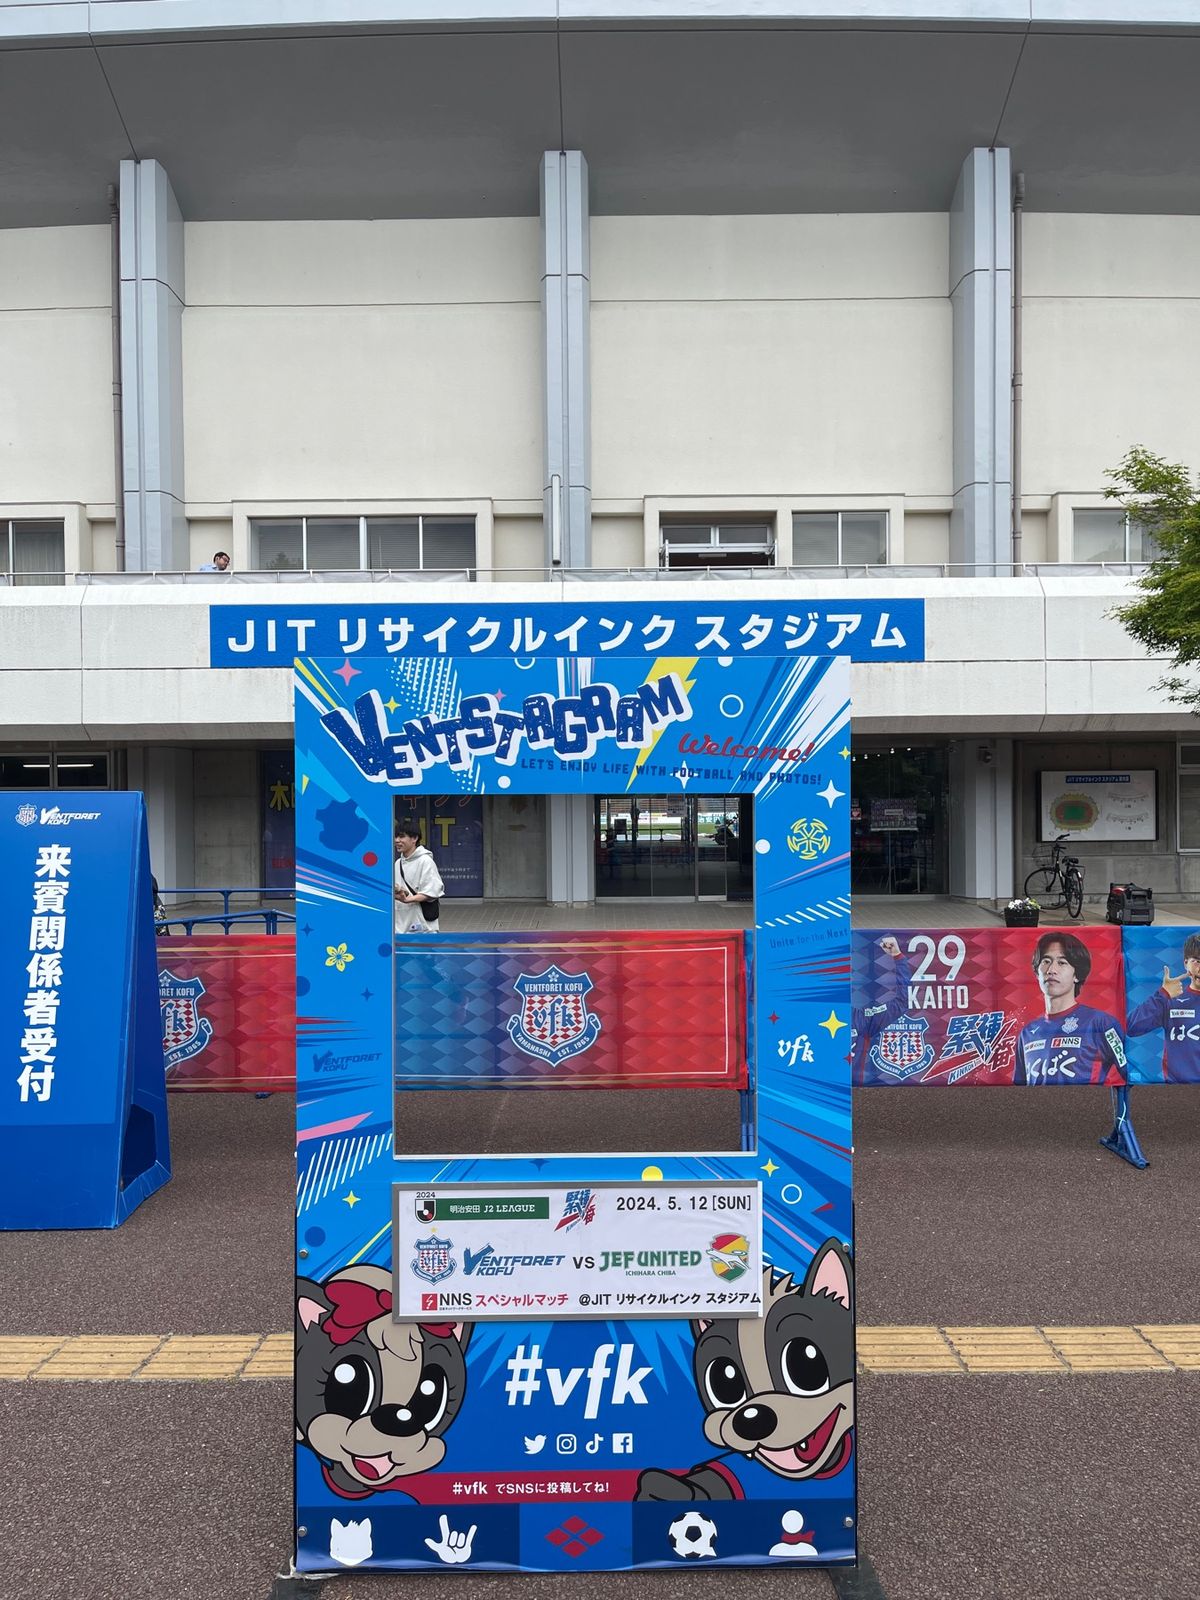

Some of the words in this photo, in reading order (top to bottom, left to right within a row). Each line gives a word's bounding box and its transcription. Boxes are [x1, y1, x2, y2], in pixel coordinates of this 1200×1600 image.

[227, 619, 316, 653] JIT
[339, 614, 676, 654] リサイクルインク
[694, 612, 908, 650] スタジアム
[320, 672, 693, 787] VENTSTAGRAM
[678, 732, 816, 763] Welcome!
[520, 758, 554, 770] LET'S
[560, 760, 598, 772] ENJOY
[603, 763, 629, 775] LIFE
[635, 764, 667, 776] WITH
[673, 766, 733, 780] FOOTBALL
[740, 769, 763, 782] AND
[769, 771, 822, 785] PHOTOS!
[770, 938, 795, 949] Unite
[826, 928, 848, 939] Next
[907, 935, 967, 982] 29
[17, 843, 72, 1102] 来賓関係者受付
[176, 988, 195, 996] KOFU
[524, 983, 562, 992] VENTFORET
[564, 982, 583, 991] KOFU
[907, 985, 969, 1010] KAITO
[531, 997, 577, 1038] vfk
[515, 1032, 552, 1058] YAMANASHI
[574, 1035, 590, 1049] 1965
[777, 1034, 815, 1067] vfk
[887, 1034, 917, 1060] vfk
[1061, 1037, 1080, 1046] NNS
[313, 1050, 382, 1072] VENTFORET
[323, 1063, 350, 1072] KOFU
[1027, 1050, 1077, 1078] くばく
[450, 1205, 481, 1213] 明治安田
[483, 1205, 494, 1213] J2
[496, 1204, 535, 1213] LEAGUE
[463, 1242, 565, 1276] VENTFORET
[475, 1267, 516, 1276] KOFU
[573, 1257, 595, 1269] VS
[599, 1250, 635, 1272] JEF
[637, 1250, 702, 1267] UNITED
[439, 1293, 472, 1306] NNS
[475, 1294, 569, 1307] スペシャルマッチ
[579, 1294, 612, 1306] @JIT
[616, 1292, 702, 1305] リサイクルインク
[706, 1292, 761, 1304] スタジアム
[505, 1343, 654, 1419] #vfk
[452, 1482, 488, 1495] #vfk
[495, 1482, 610, 1494] でSNSに投稿してね!
